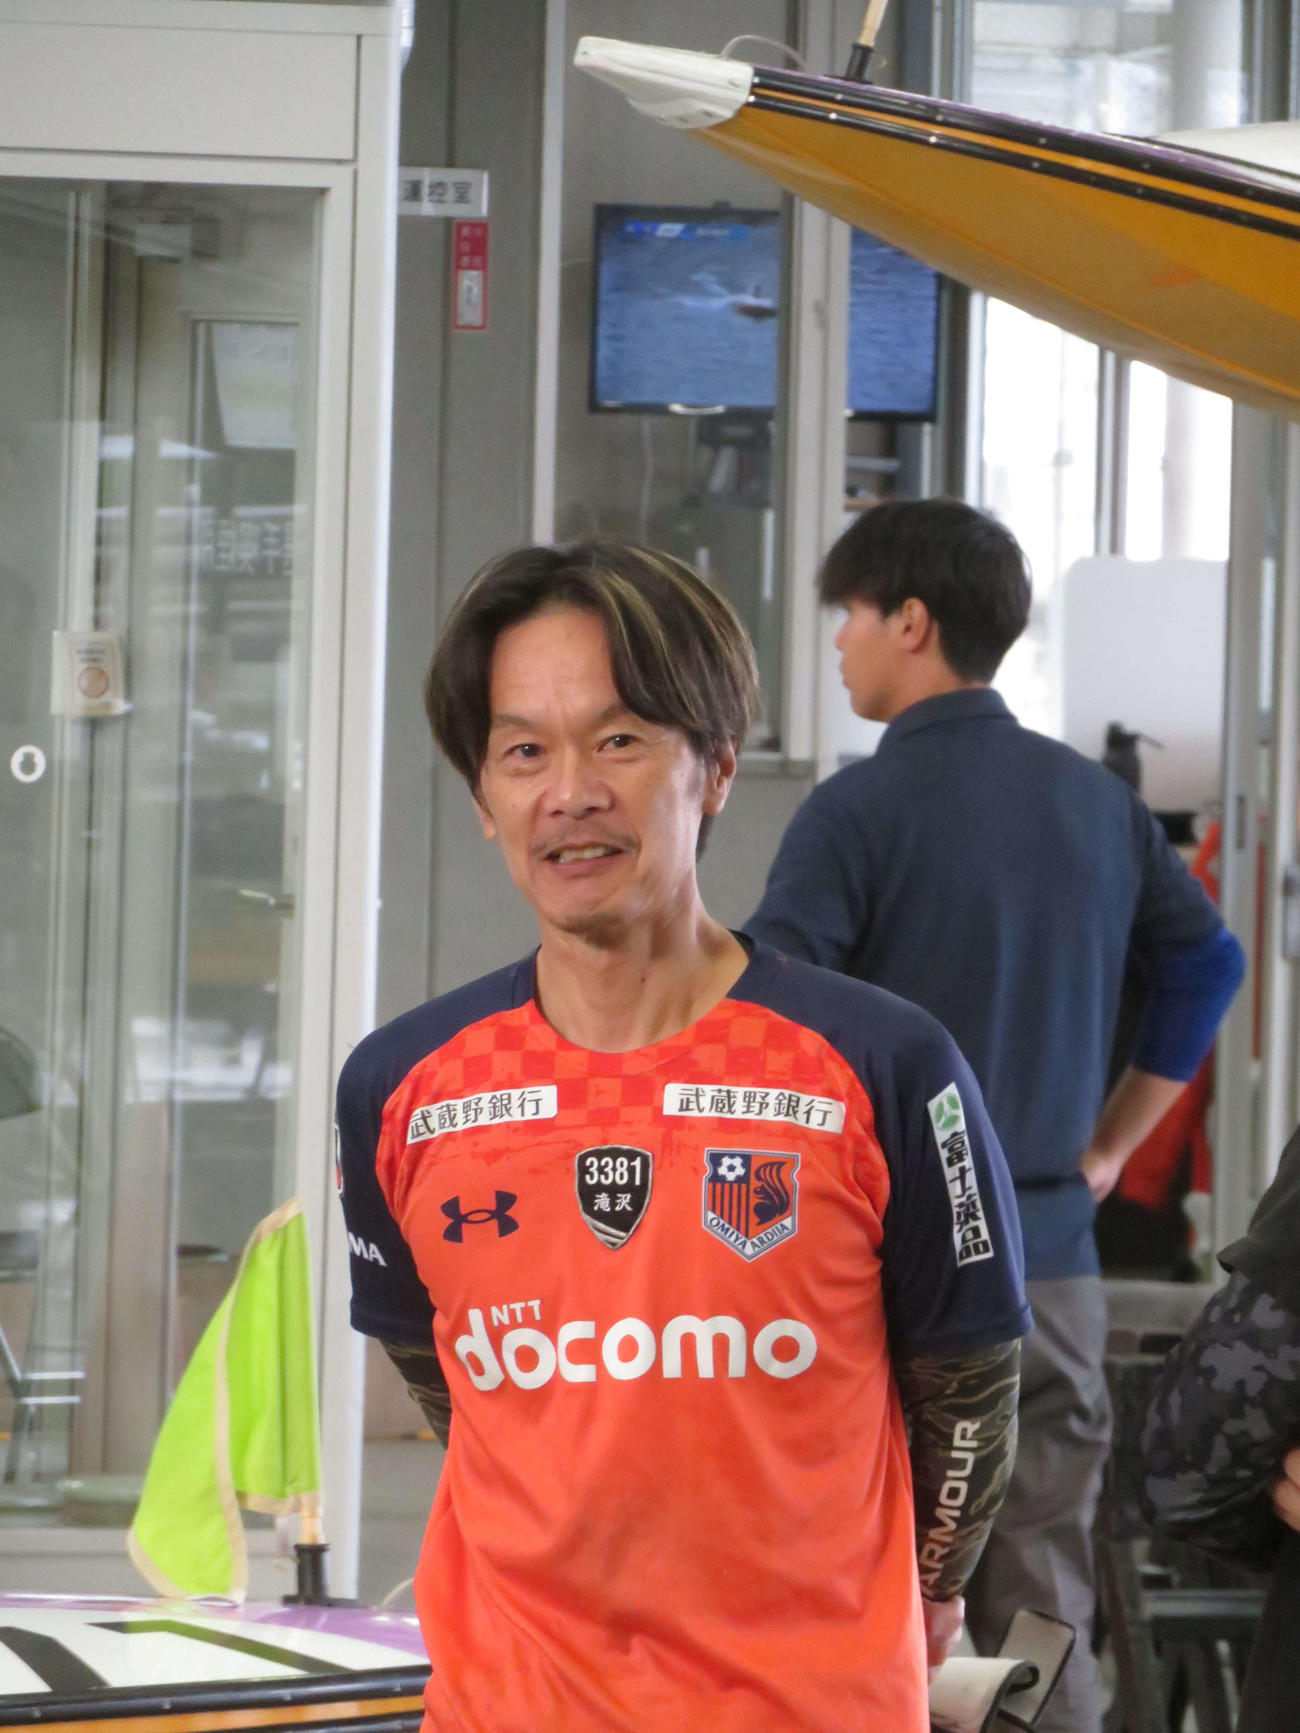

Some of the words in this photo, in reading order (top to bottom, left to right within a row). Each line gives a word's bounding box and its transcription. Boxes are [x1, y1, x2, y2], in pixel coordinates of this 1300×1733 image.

[410, 1090, 543, 1140] 武蔵野銀行
[678, 1086, 833, 1128] 武蔵野銀行
[585, 1156, 641, 1186] 3381
[593, 1192, 633, 1212] 滝沢
[941, 1131, 990, 1262] 富士薬品
[708, 1216, 748, 1251] OMIYA
[750, 1222, 791, 1252] ARDIJA
[491, 1299, 541, 1327] NTT
[455, 1308, 818, 1391] docomo
[919, 1420, 981, 1595] ARMOUR
